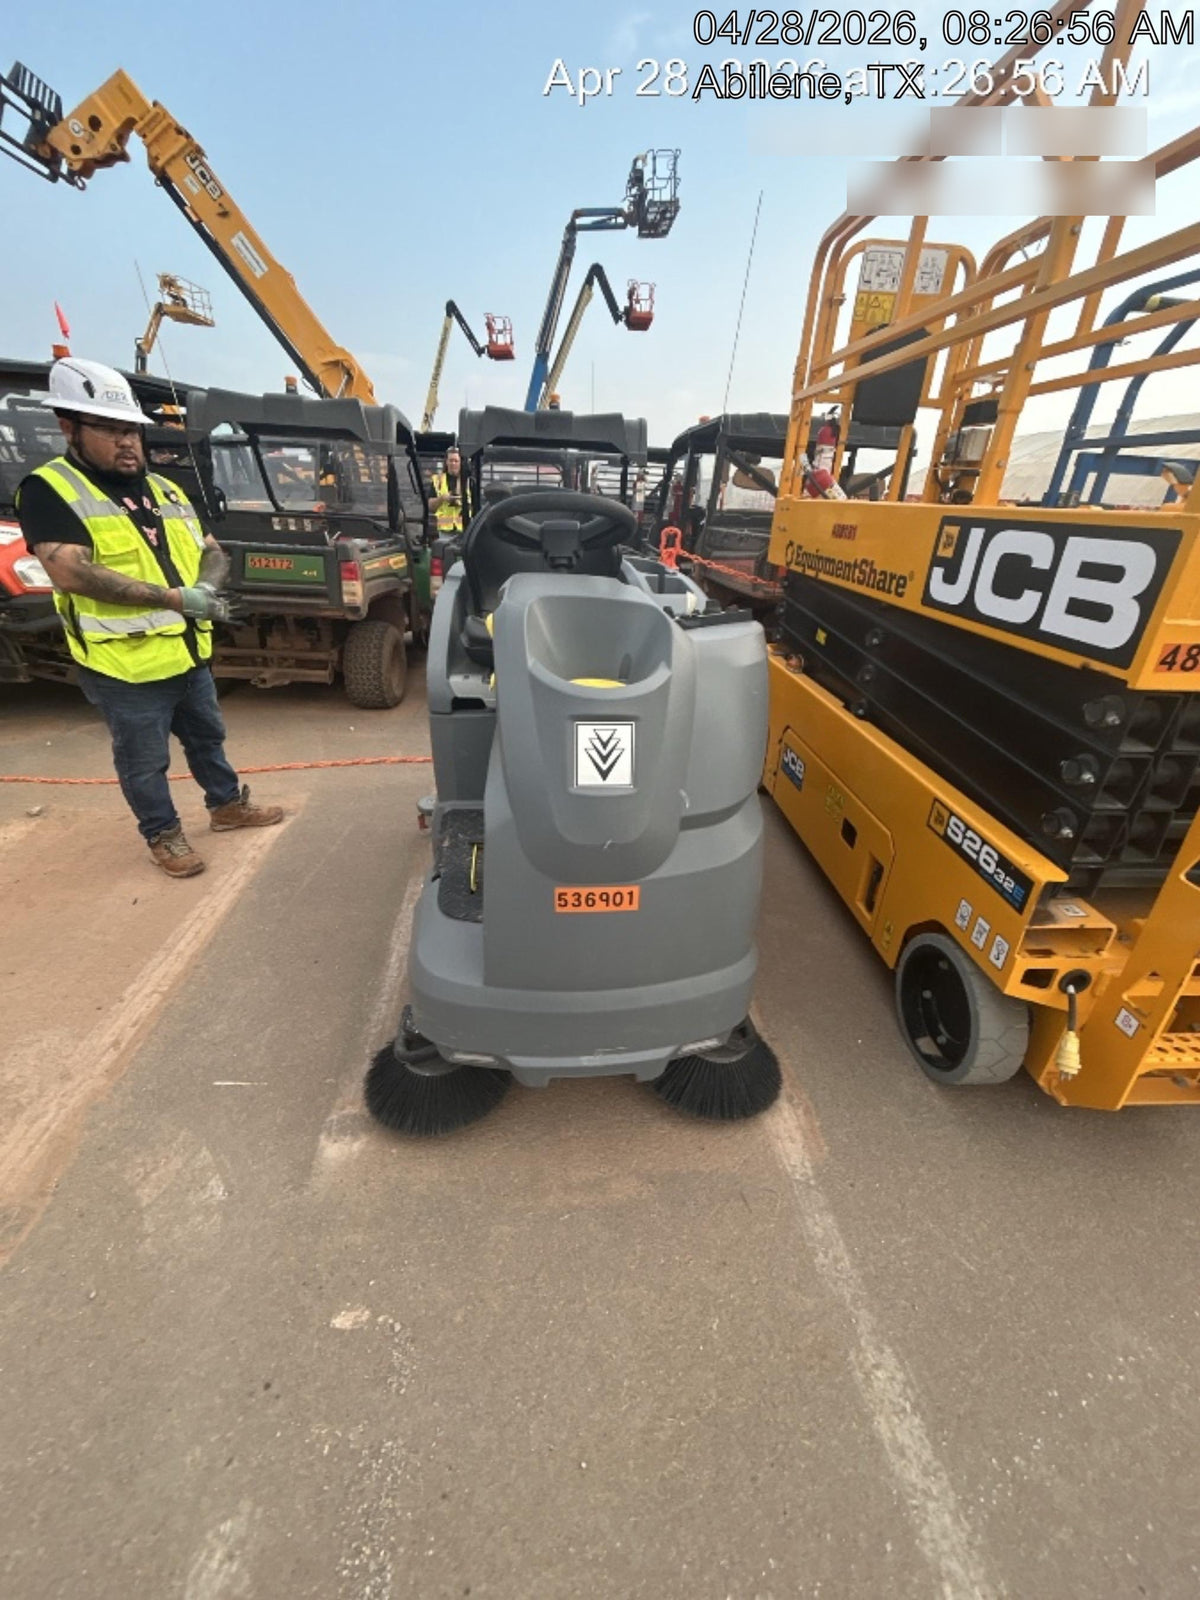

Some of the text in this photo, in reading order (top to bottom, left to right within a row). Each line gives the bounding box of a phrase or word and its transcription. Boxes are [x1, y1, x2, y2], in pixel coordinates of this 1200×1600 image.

[186, 155, 222, 200] JCB
[929, 527, 1157, 650] JCB
[1159, 643, 1200, 672] 48
[783, 748, 805, 780] JCB
[557, 889, 635, 908] 536901
